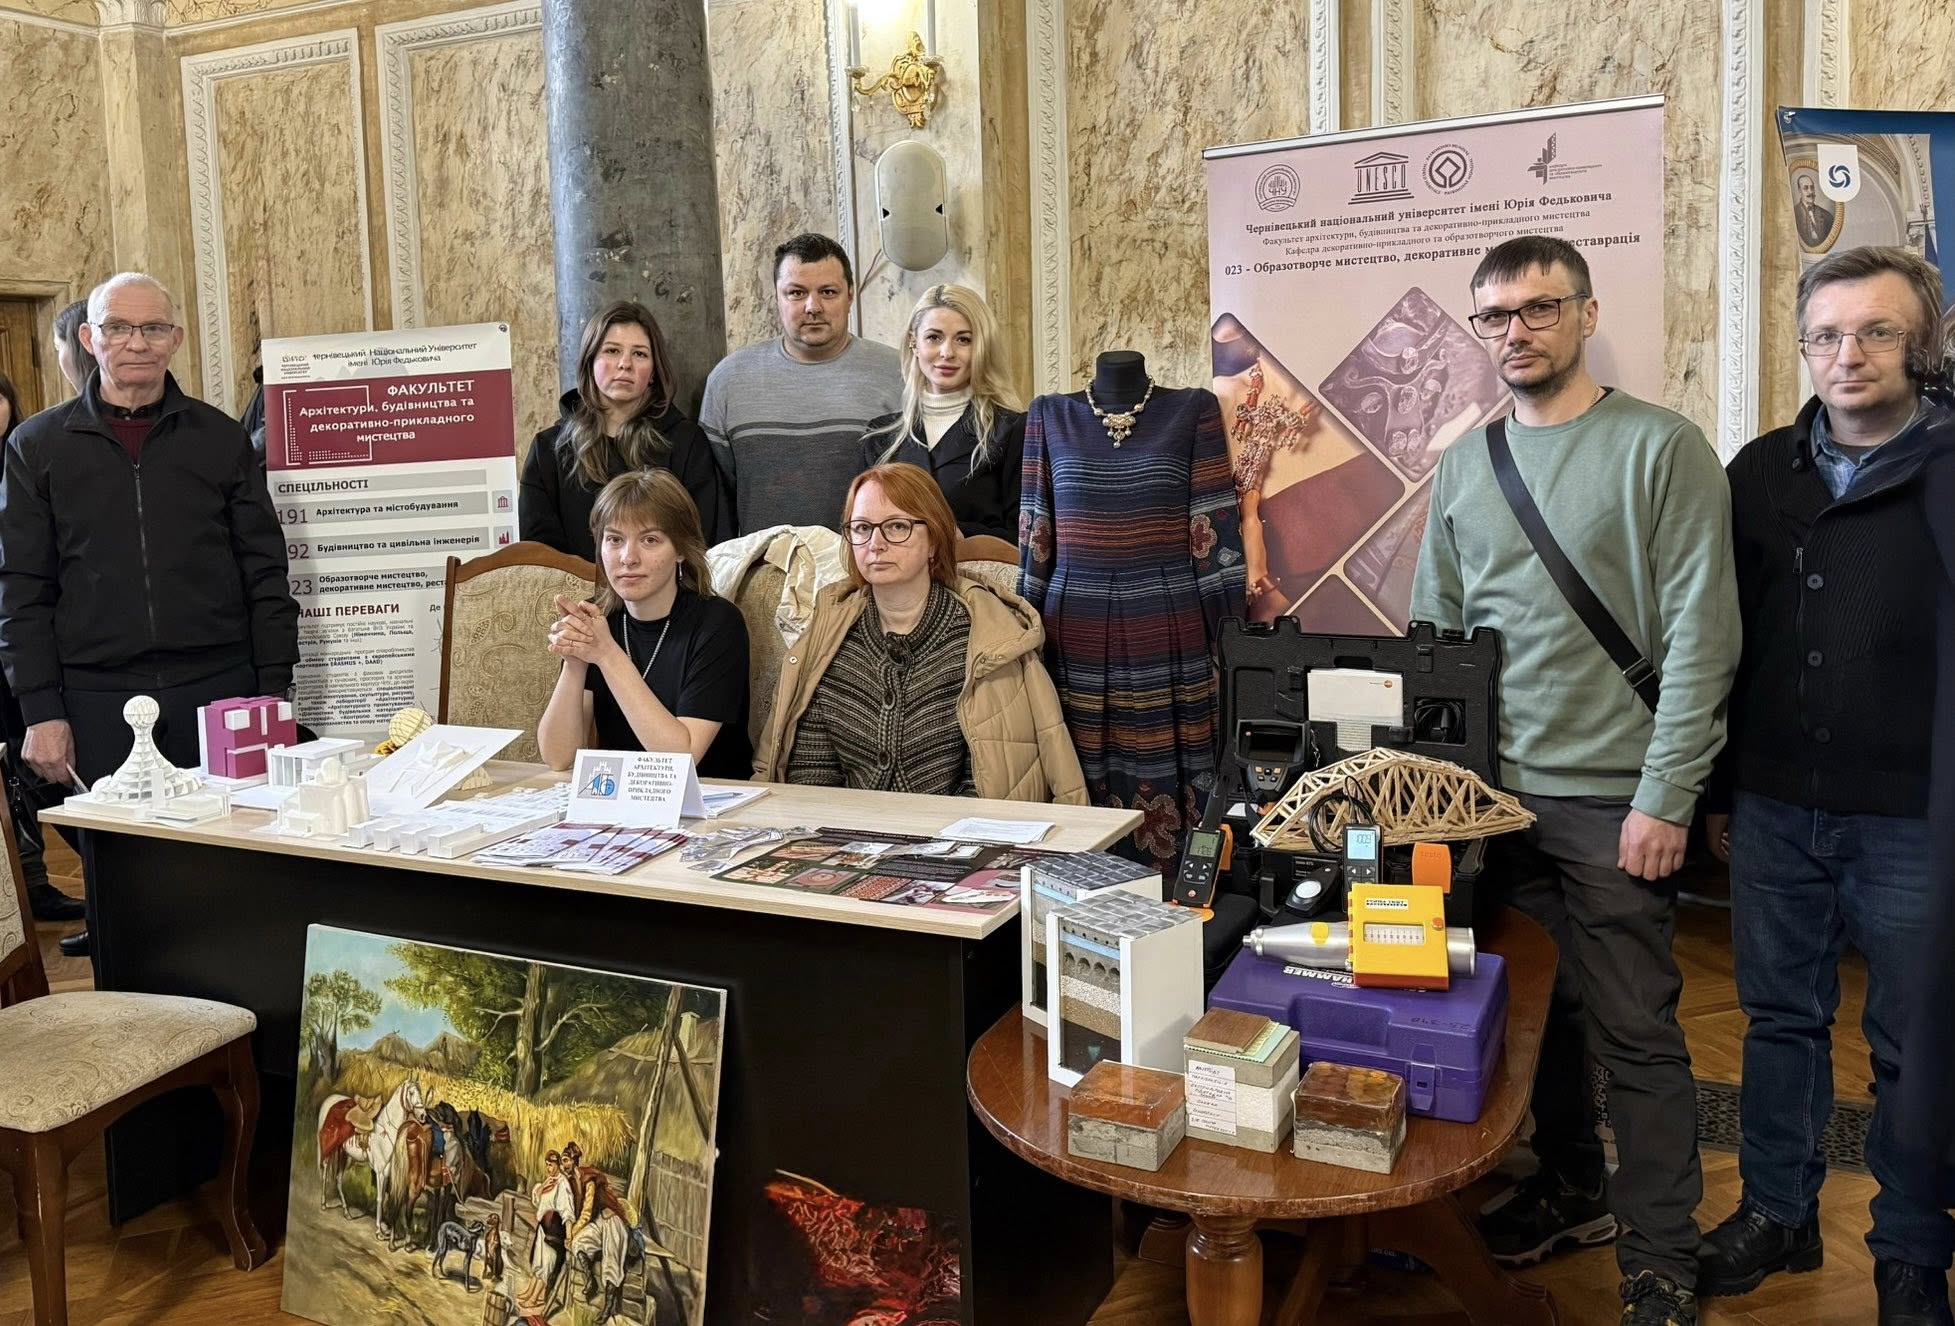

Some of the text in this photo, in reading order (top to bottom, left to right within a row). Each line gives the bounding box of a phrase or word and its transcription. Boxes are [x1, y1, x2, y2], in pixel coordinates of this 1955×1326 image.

[1356, 164, 1406, 193] UNESCO
[1246, 192, 1613, 235] Чернівецький національний університет імені Юрія Федьковича
[1262, 236, 1304, 247] Факультет
[1306, 231, 1358, 243] архітектури,
[1359, 227, 1410, 240] будівництва
[1424, 214, 1540, 232] декоративно-прикладного
[1543, 209, 1590, 220] мистецтва
[1285, 246, 1320, 257] Кафедра
[1322, 236, 1431, 253] декоративно-прикладного
[1444, 228, 1514, 242] образотворчого
[1516, 225, 1564, 236] мистецтва
[1225, 264, 1242, 276] 023
[1254, 258, 1332, 275] Образотворче
[1335, 253, 1401, 268] мистецтво,
[1404, 246, 1481, 262] декоративне
[371, 357, 392, 367] Юрія
[387, 379, 475, 397] ФАКУЛЬТЕТ
[381, 400, 458, 414] будівництва
[461, 398, 475, 406] та
[310, 414, 475, 432] декоративно-прикладного
[356, 430, 416, 443] мистецтва
[278, 479, 369, 494] СПЕЦІЛЬНОСТІ
[316, 506, 371, 518] Архітектура
[386, 500, 459, 512] містобудування
[317, 542, 375, 554] Будівництво
[377, 541, 387, 549] та
[389, 538, 431, 550] цивільна
[433, 534, 480, 546] інженерія
[319, 574, 379, 585] Образотворче
[381, 571, 428, 580] мистецтво,
[319, 582, 375, 594] декоративне
[376, 580, 424, 590] мистецтво,
[335, 604, 400, 616] ПЕРЕВАГИ
[430, 604, 441, 612] Де
[1283, 966, 1354, 984] HAMMER
